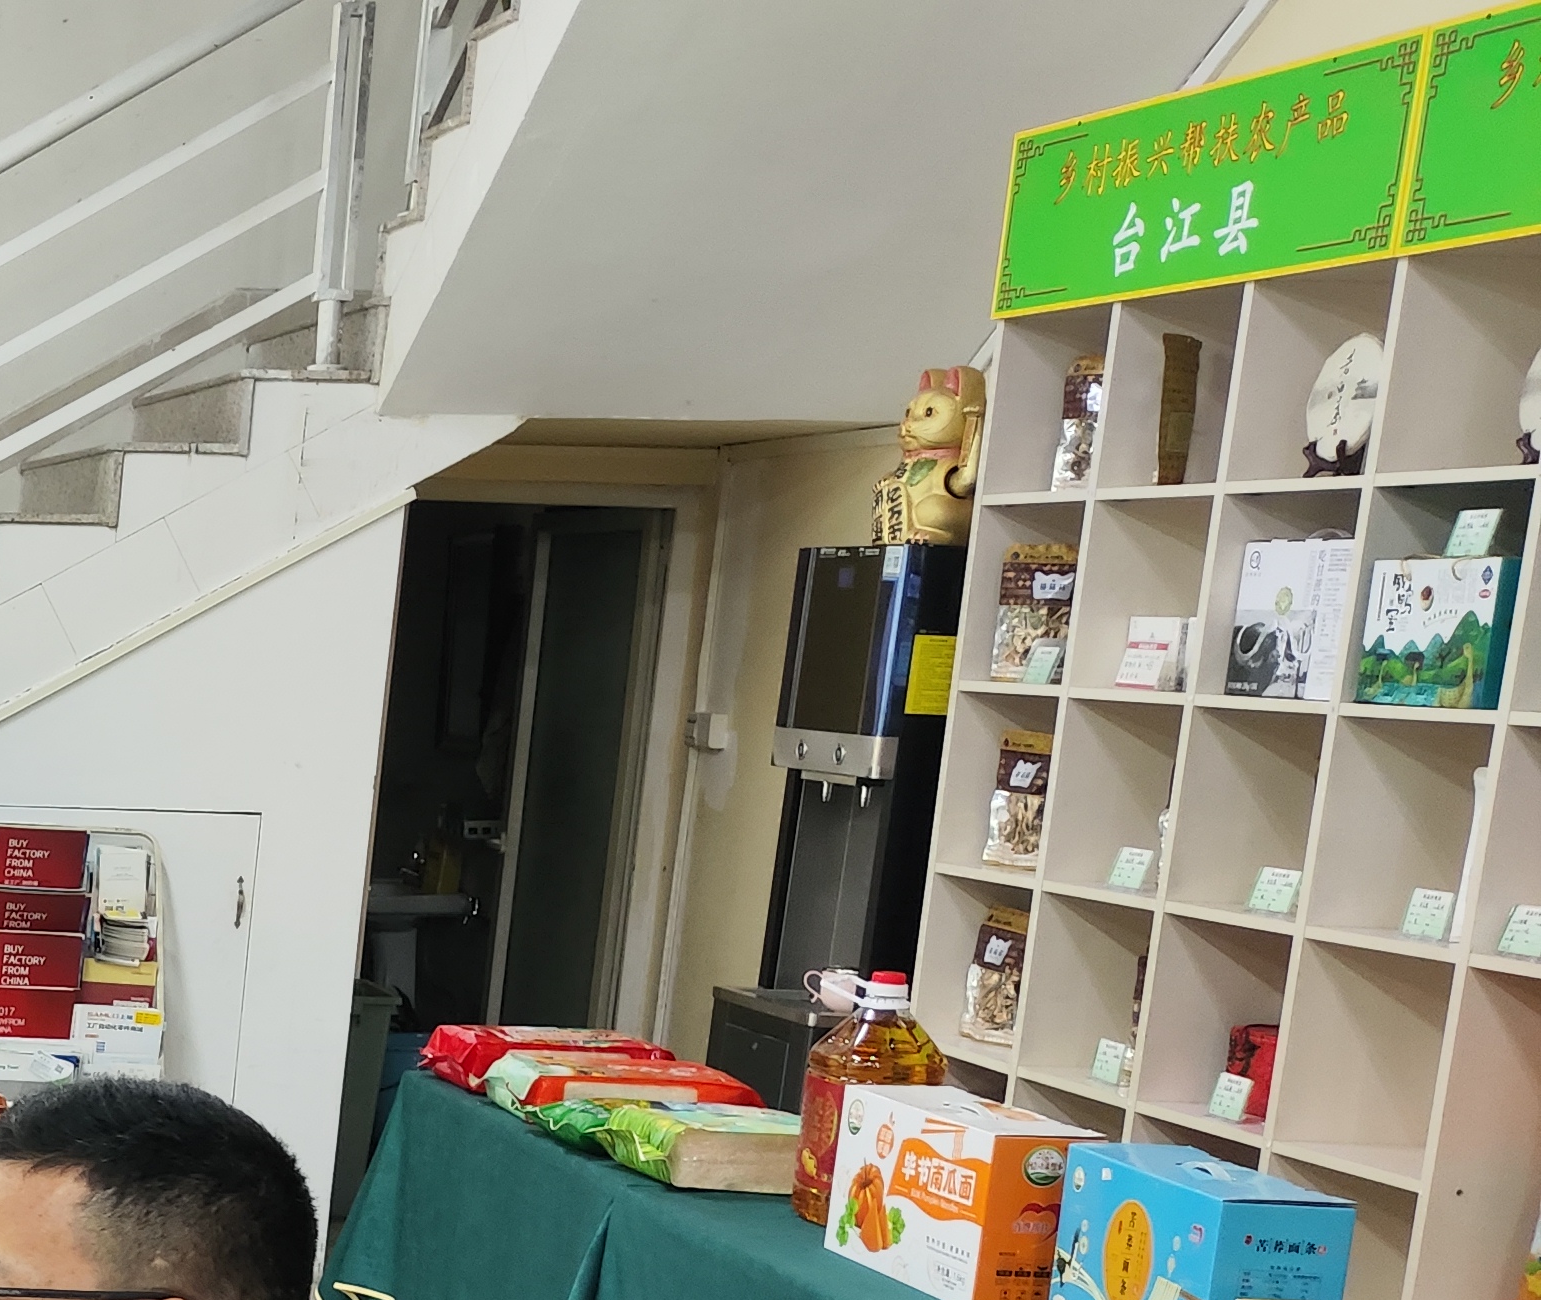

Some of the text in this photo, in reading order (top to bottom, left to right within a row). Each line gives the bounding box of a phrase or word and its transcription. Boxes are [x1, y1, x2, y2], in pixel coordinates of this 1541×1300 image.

[1054, 88, 1349, 206] 乡村振兴帮扶农产品
[1111, 179, 1260, 279] 台江县
[8, 838, 29, 848] BUY
[6, 848, 51, 859] FACTORY
[5, 858, 33, 868] FROM
[4, 868, 33, 878] CHINA
[5, 902, 27, 911] BUY
[4, 911, 48, 921] FACTORY
[2, 919, 31, 929] FROM
[3, 944, 25, 955] BUY
[2, 954, 47, 966] FACTORY
[1, 965, 30, 976] FROM
[0, 976, 30, 986] CHINA
[901, 1150, 975, 1202] 毕节南瓜面
